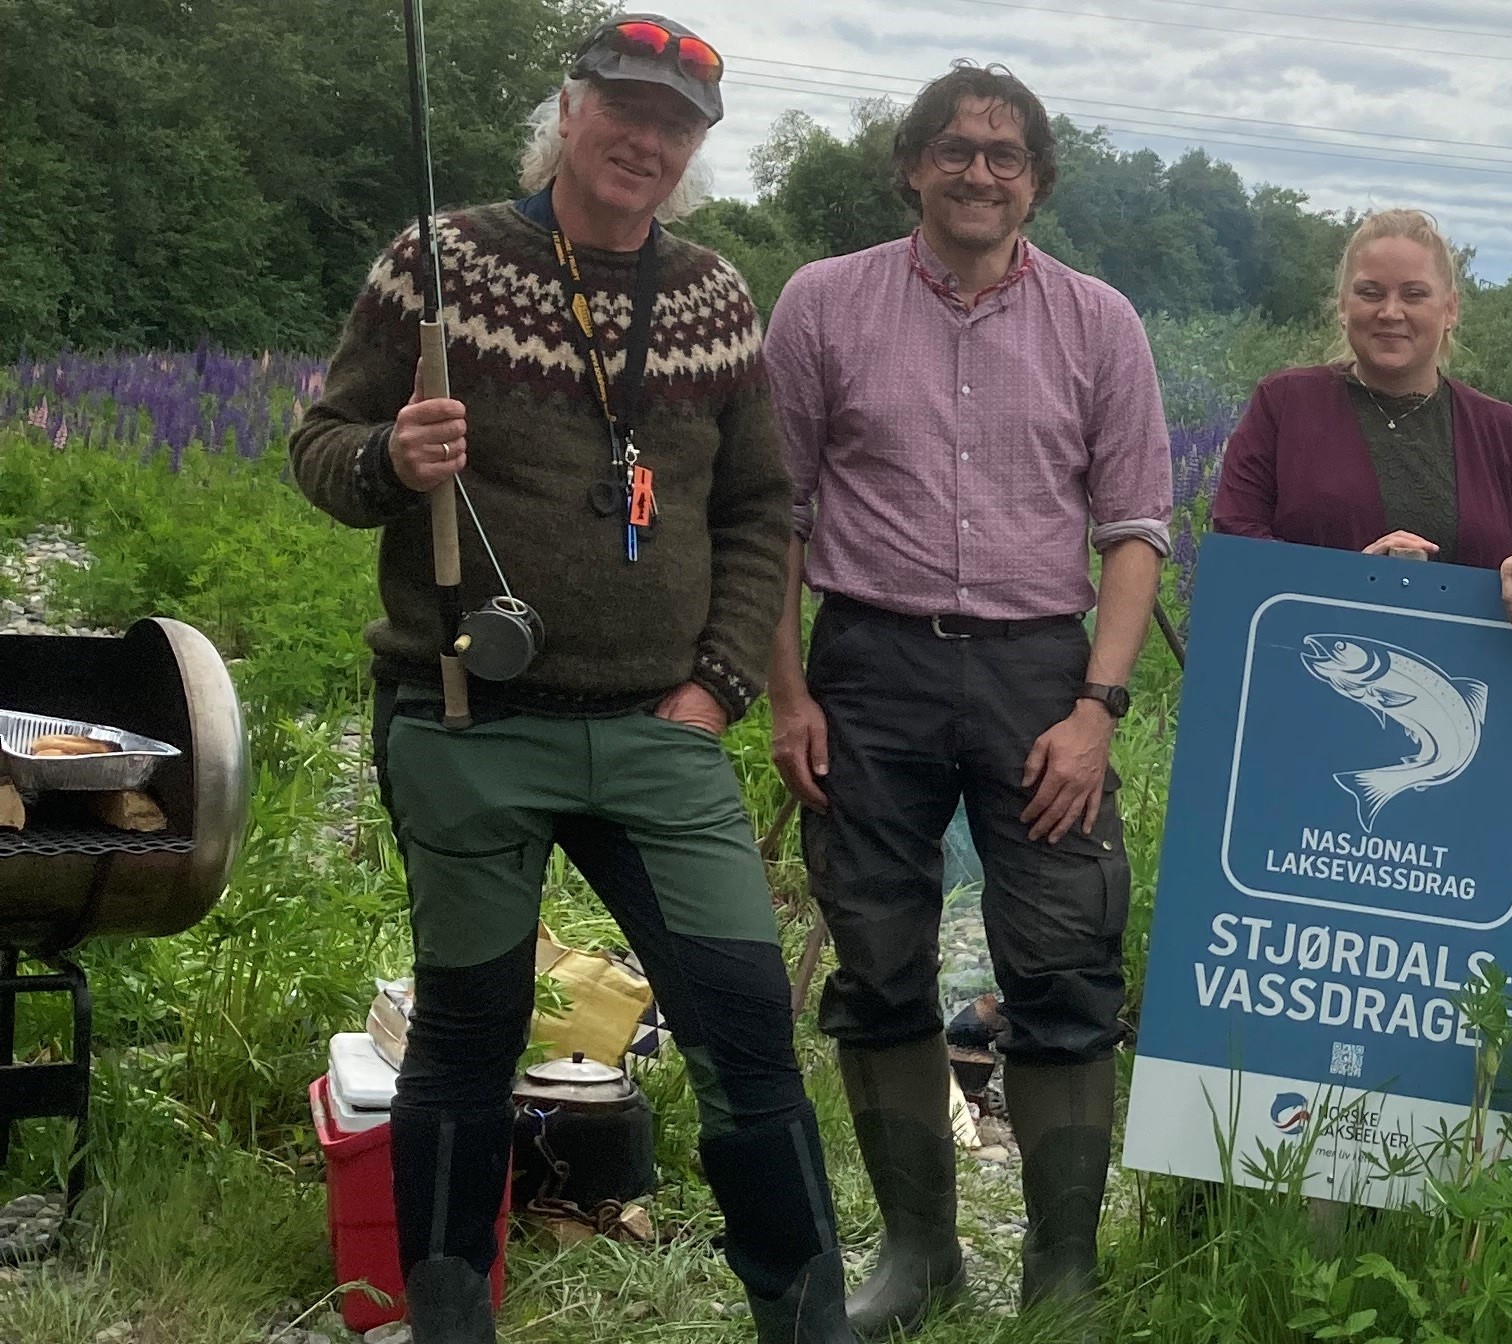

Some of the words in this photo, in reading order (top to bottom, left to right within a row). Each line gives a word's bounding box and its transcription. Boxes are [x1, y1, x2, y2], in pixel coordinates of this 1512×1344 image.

[1301, 827, 1449, 869] NASJONALT
[1266, 849, 1476, 900] LAKSEVASSDRAG
[1319, 1124, 1410, 1149] AKSEELVER
